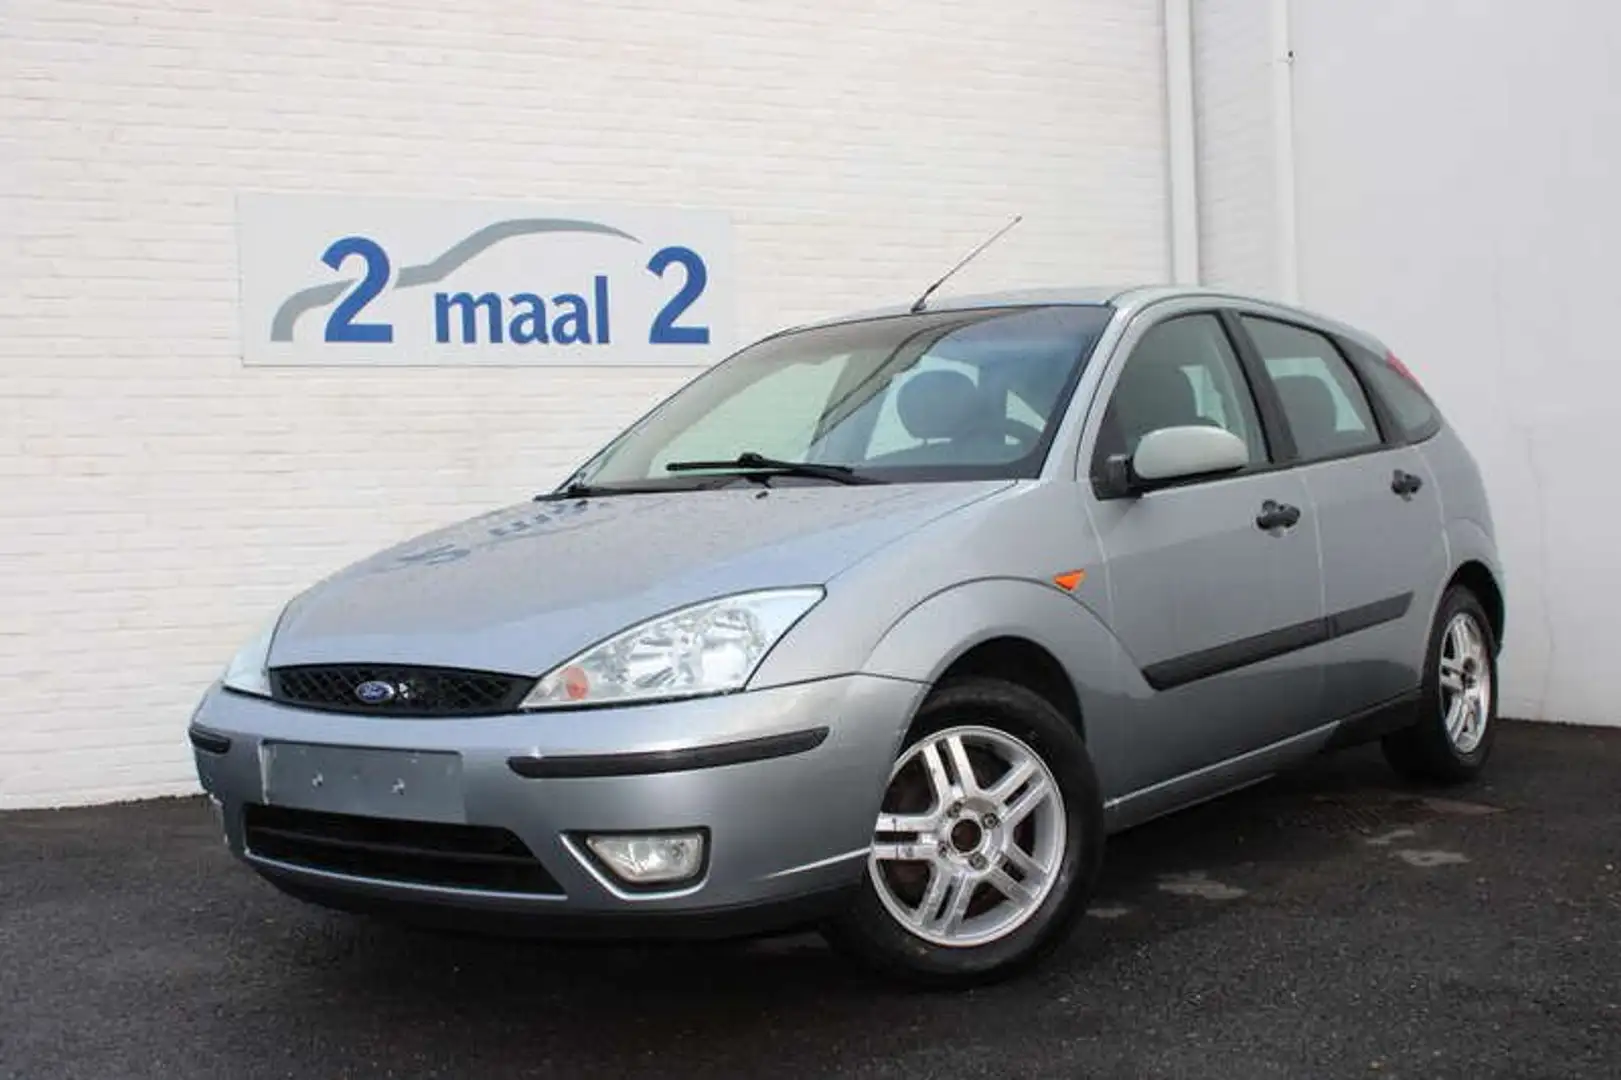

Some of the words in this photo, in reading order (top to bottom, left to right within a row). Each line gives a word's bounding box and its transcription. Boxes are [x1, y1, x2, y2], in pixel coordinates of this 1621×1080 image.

[321, 237, 394, 343] 2
[434, 275, 610, 345] maal
[647, 246, 710, 345] 2
